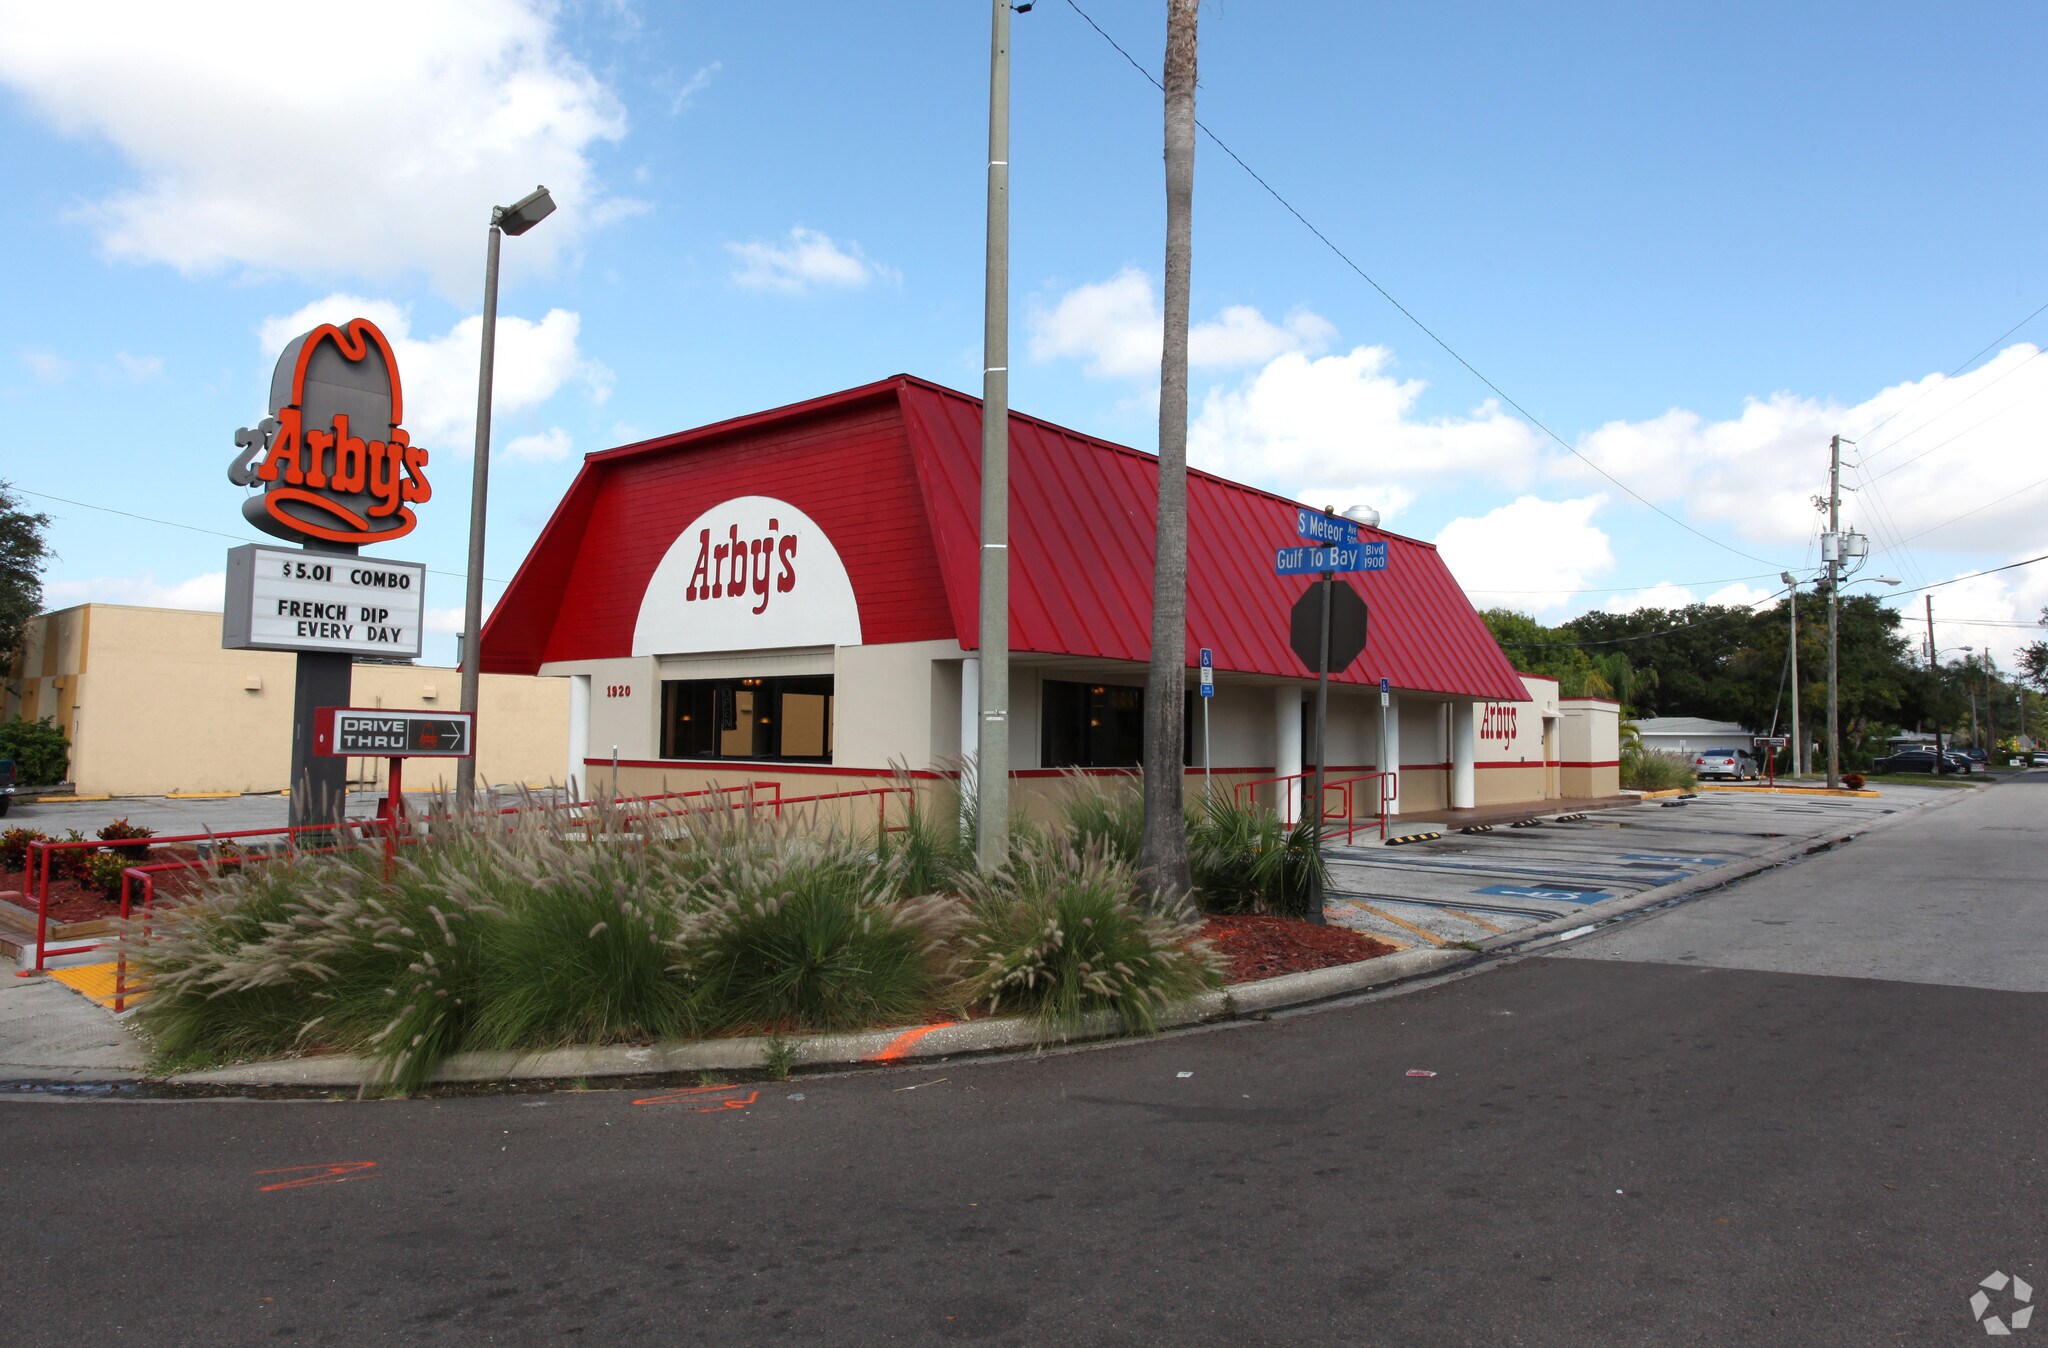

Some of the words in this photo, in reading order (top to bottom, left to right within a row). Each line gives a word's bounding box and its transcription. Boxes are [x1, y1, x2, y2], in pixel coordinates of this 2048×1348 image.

[258, 407, 432, 517] Arby's
[1298, 512, 1306, 533] S
[1309, 515, 1343, 542] Meteor
[1347, 524, 1357, 535] Ave
[1277, 548, 1303, 570] Gulf
[1309, 548, 1323, 567] To
[1329, 546, 1358, 570] Bay
[1365, 545, 1384, 555] Blvd
[686, 518, 797, 615] Arby's
[1364, 557, 1385, 568] 1900
[283, 562, 332, 581] $5.01
[350, 569, 410, 589] COMBO
[278, 600, 347, 621] FRENCH
[360, 607, 389, 623] DIP
[297, 621, 354, 640] EVERY
[367, 626, 402, 643] DAY
[607, 685, 631, 697] 1920
[343, 719, 405, 733] DRIVE
[343, 735, 404, 748] THRU
